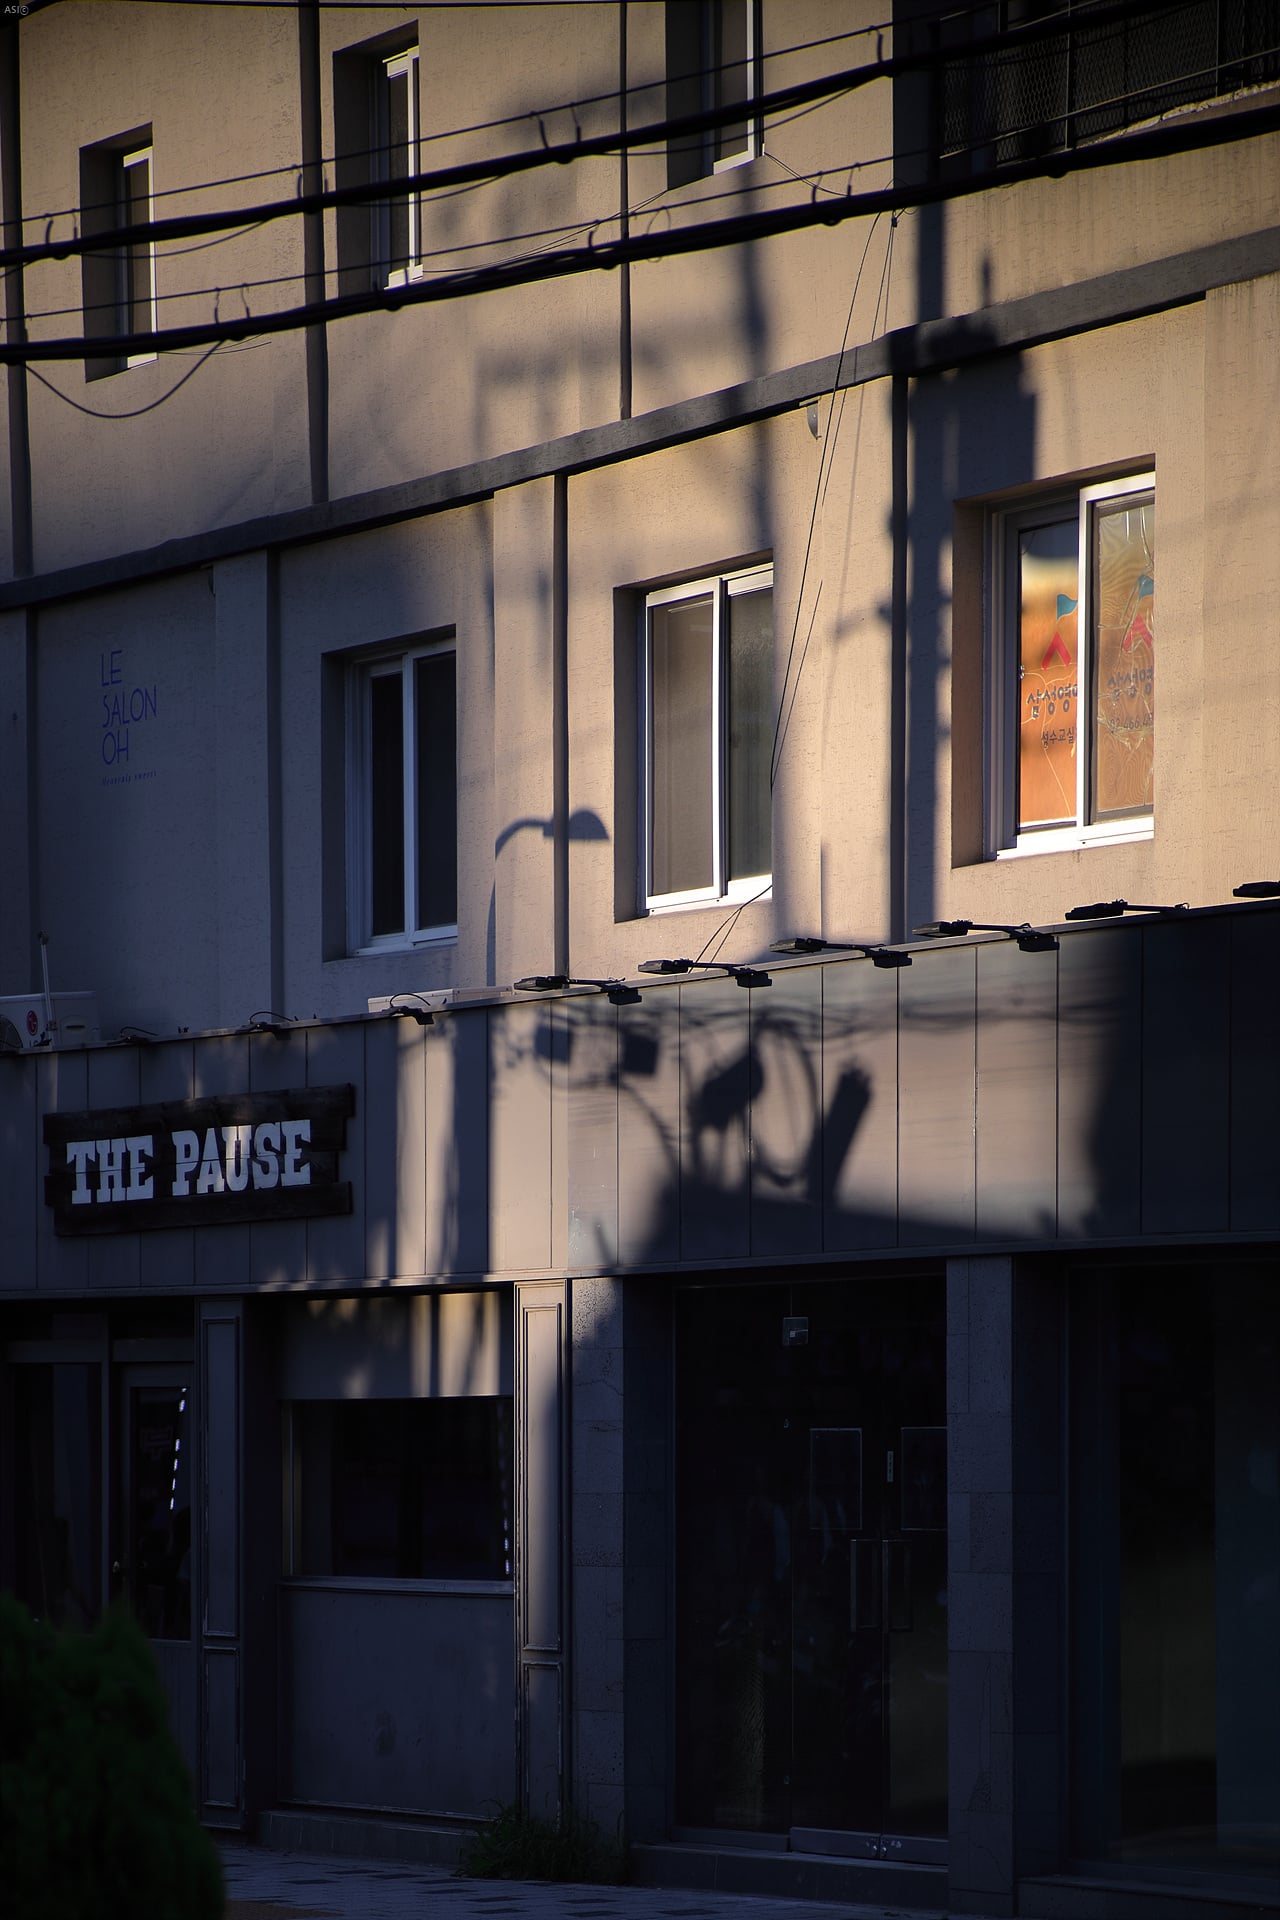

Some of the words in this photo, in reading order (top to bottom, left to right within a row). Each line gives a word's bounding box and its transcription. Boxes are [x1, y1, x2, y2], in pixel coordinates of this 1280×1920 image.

[101, 650, 122, 687] LE
[102, 684, 157, 729] SALON
[102, 727, 129, 765] OH
[66, 1135, 155, 1205] THE
[171, 1119, 312, 1197] PAUSE
